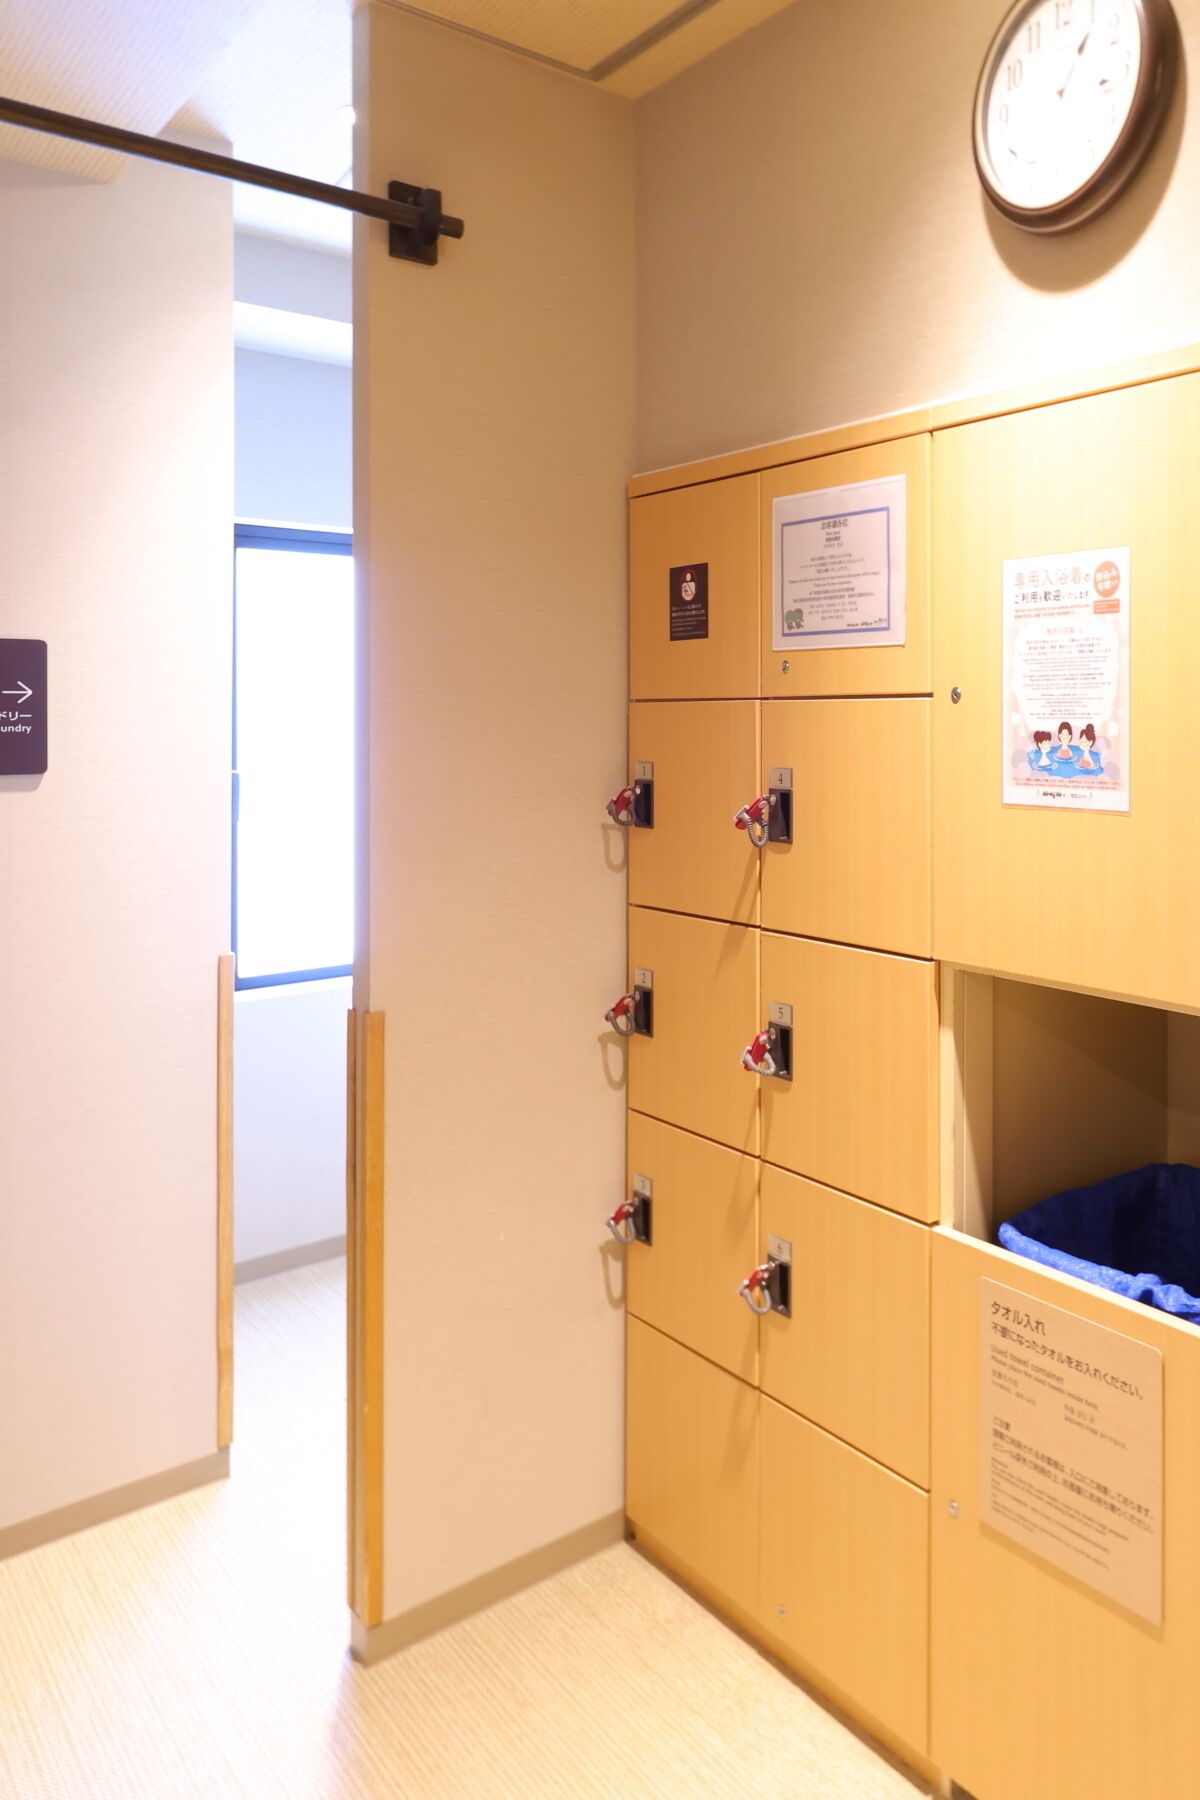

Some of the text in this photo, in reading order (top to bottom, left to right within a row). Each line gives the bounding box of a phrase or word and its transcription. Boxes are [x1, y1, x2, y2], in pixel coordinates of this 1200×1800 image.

[1006, 58, 1024, 92] 10
[778, 772, 784, 785] 4
[642, 972, 647, 984] 2
[778, 1007, 784, 1020] 5
[991, 1300, 1046, 1337] タオル入れ
[991, 1321, 1144, 1401] 不要になったタオルをお入れください。
